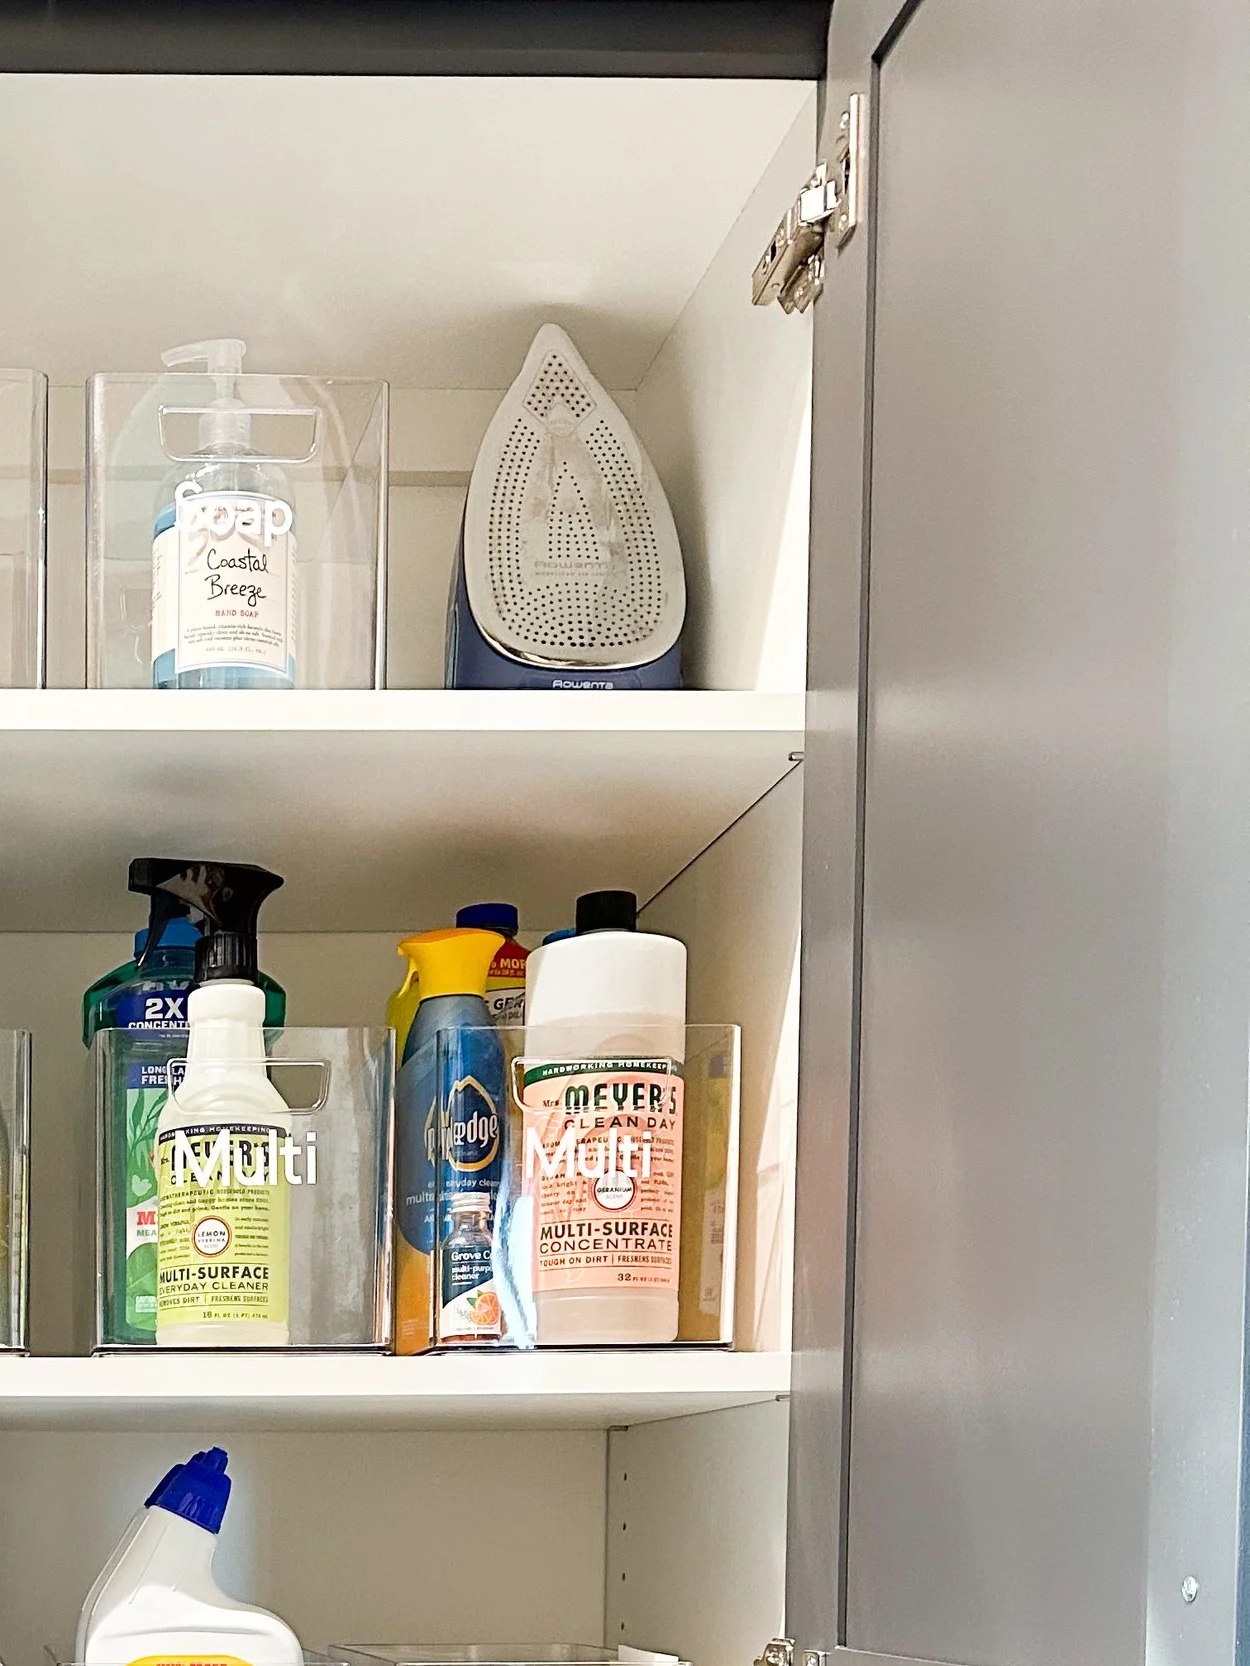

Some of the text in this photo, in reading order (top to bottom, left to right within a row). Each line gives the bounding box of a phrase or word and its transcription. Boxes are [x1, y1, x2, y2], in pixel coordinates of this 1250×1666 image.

[174, 480, 293, 547] Soap
[206, 548, 269, 574] Coastal
[204, 573, 267, 608] Breeze
[145, 997, 185, 1020] 2X
[542, 1061, 613, 1077] HARDWORKING
[564, 1082, 678, 1115] MEYER'S
[564, 1116, 676, 1131] CLEAN DAY
[174, 1128, 318, 1187] Multi
[526, 1126, 652, 1179] Multi
[540, 1221, 673, 1240] MULTI-SURFACE
[539, 1238, 672, 1254] CONCENTRATE
[451, 1250, 482, 1261] Grove
[540, 1255, 609, 1267] TOUGH ON DIRT
[159, 1266, 269, 1283] MULTI-SURFACE
[451, 1272, 480, 1281] cleaner
[617, 1273, 631, 1282] 32
[159, 1281, 269, 1295] EVERYDAY CLEANER
[202, 1311, 213, 1319] 16
